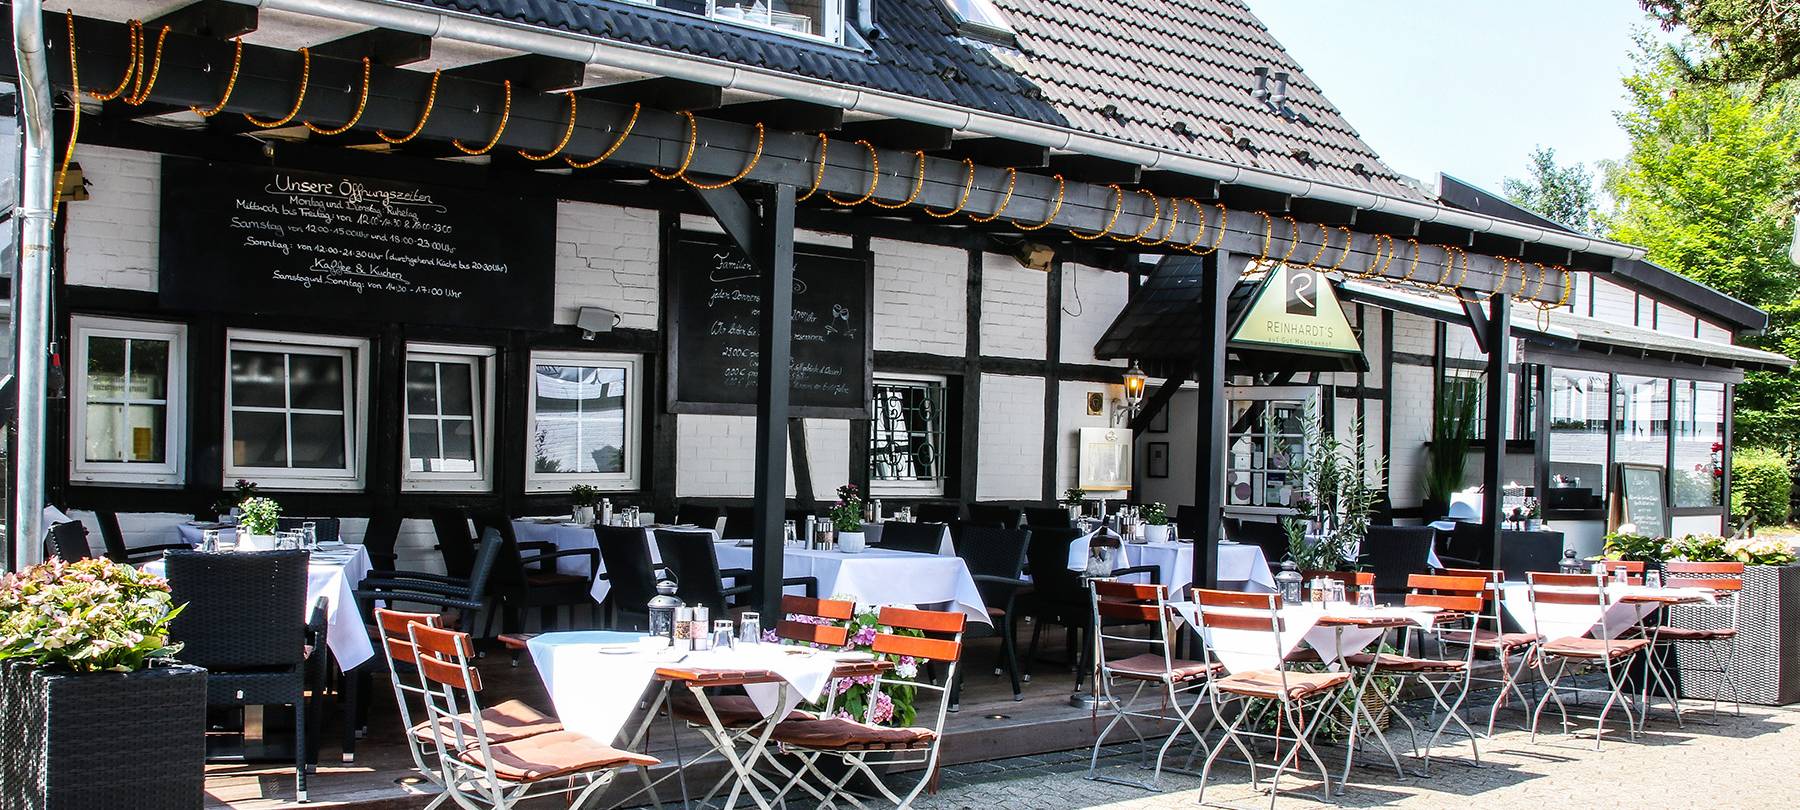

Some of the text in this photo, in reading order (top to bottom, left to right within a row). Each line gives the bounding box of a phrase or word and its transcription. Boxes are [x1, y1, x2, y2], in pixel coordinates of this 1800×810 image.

[275, 174, 433, 207] Unsere Öffnungszeiten
[236, 199, 279, 213] Mittwoch
[281, 204, 298, 216] bis
[336, 214, 352, 223] von
[289, 195, 326, 212] Montag
[326, 200, 343, 209] und
[386, 205, 420, 222] Ruhetag
[230, 216, 285, 237] Samstag
[371, 234, 388, 242] und
[244, 236, 293, 256] Sonntag:
[297, 243, 313, 252] von
[436, 257, 458, 270] Küche
[459, 261, 471, 270] bis
[314, 258, 403, 280] Kaffee & Kuchen
[367, 282, 383, 290] von
[445, 288, 463, 298] Uhr
[1290, 272, 1316, 309] R
[1266, 320, 1334, 338] REINHARDT'S
